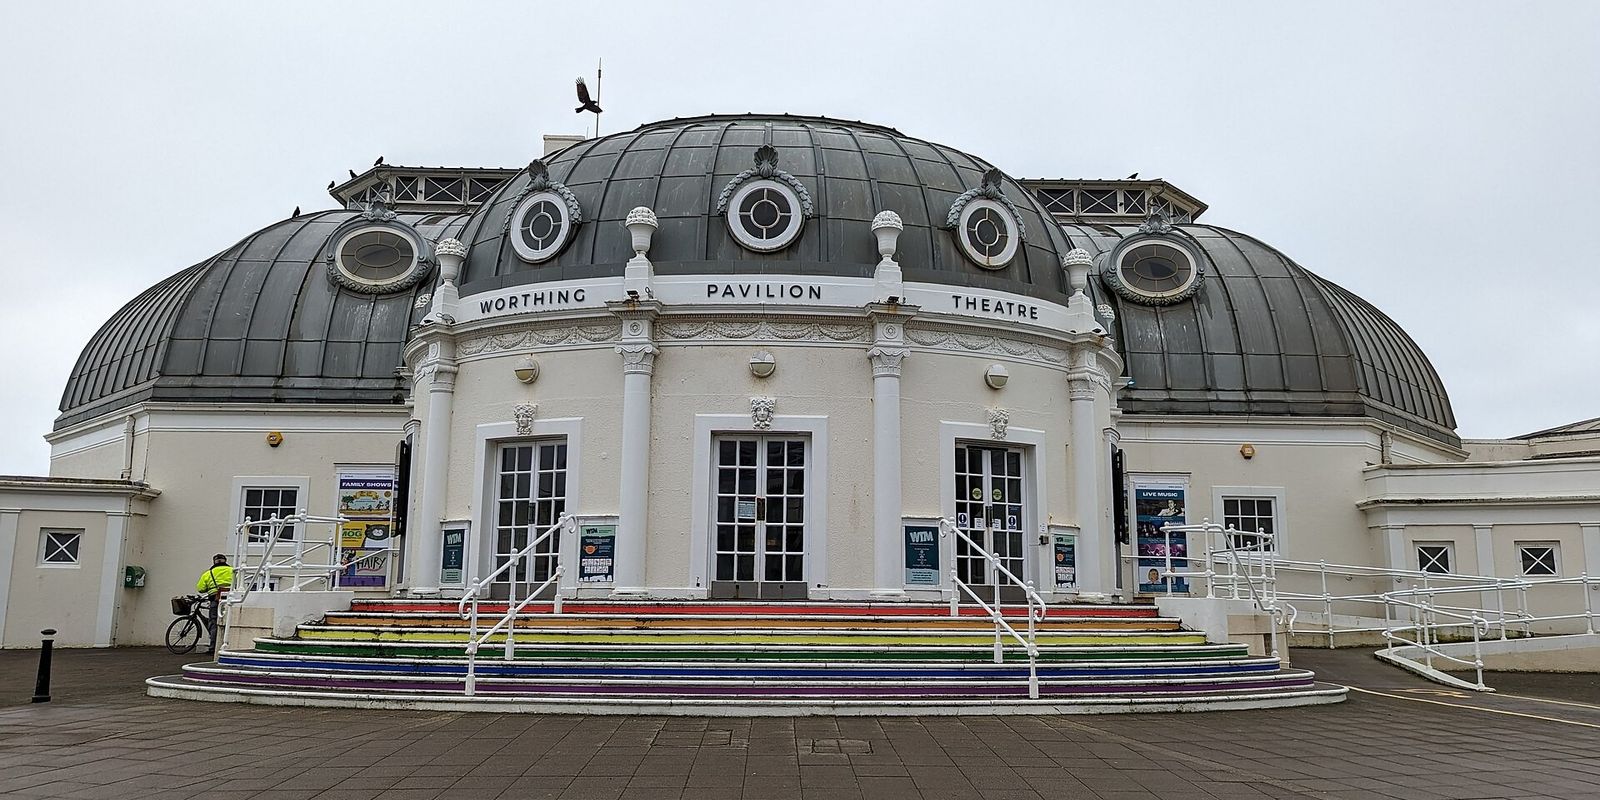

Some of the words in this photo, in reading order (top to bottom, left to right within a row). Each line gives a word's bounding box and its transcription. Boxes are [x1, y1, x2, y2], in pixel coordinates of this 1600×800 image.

[480, 289, 585, 314] WORTHING
[707, 284, 821, 299] PAVILION
[952, 295, 1038, 320] THEATRE
[910, 531, 934, 543] WTM
[356, 557, 386, 570] HAIRY
